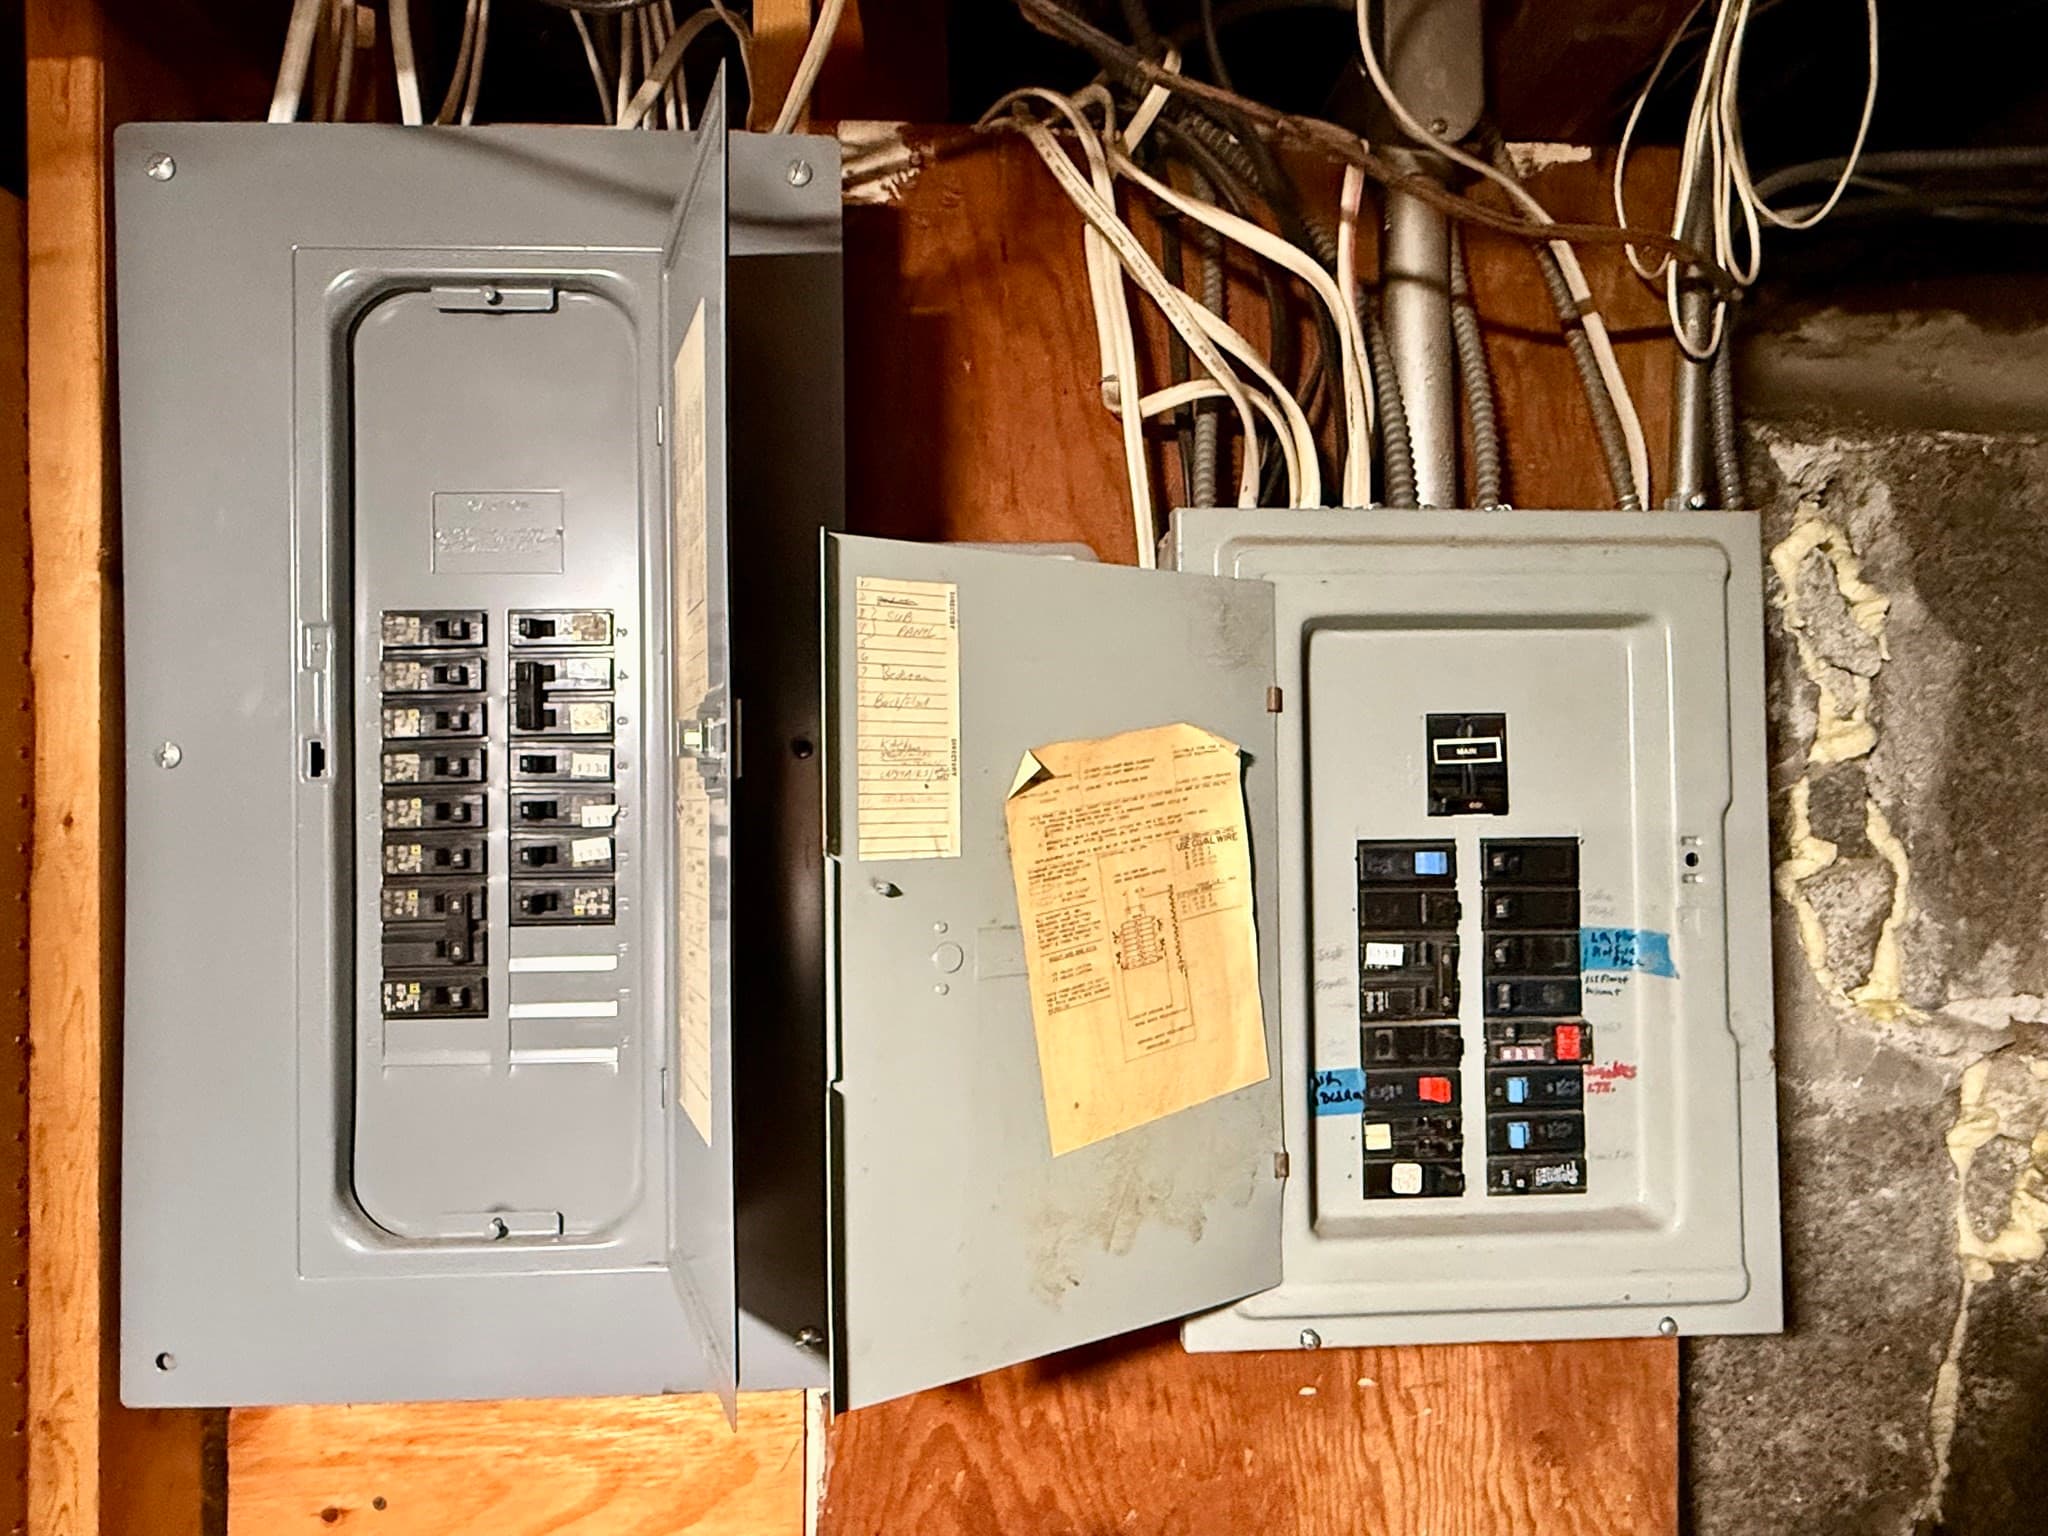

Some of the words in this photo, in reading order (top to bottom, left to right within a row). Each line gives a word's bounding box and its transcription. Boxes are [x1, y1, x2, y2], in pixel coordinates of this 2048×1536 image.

[887, 610, 913, 624] SUB
[616, 628, 628, 637] 2
[617, 669, 629, 681] 4
[1455, 746, 1478, 756] MAIN
[1175, 838, 1190, 851] USE
[1217, 831, 1238, 843] WIRE
